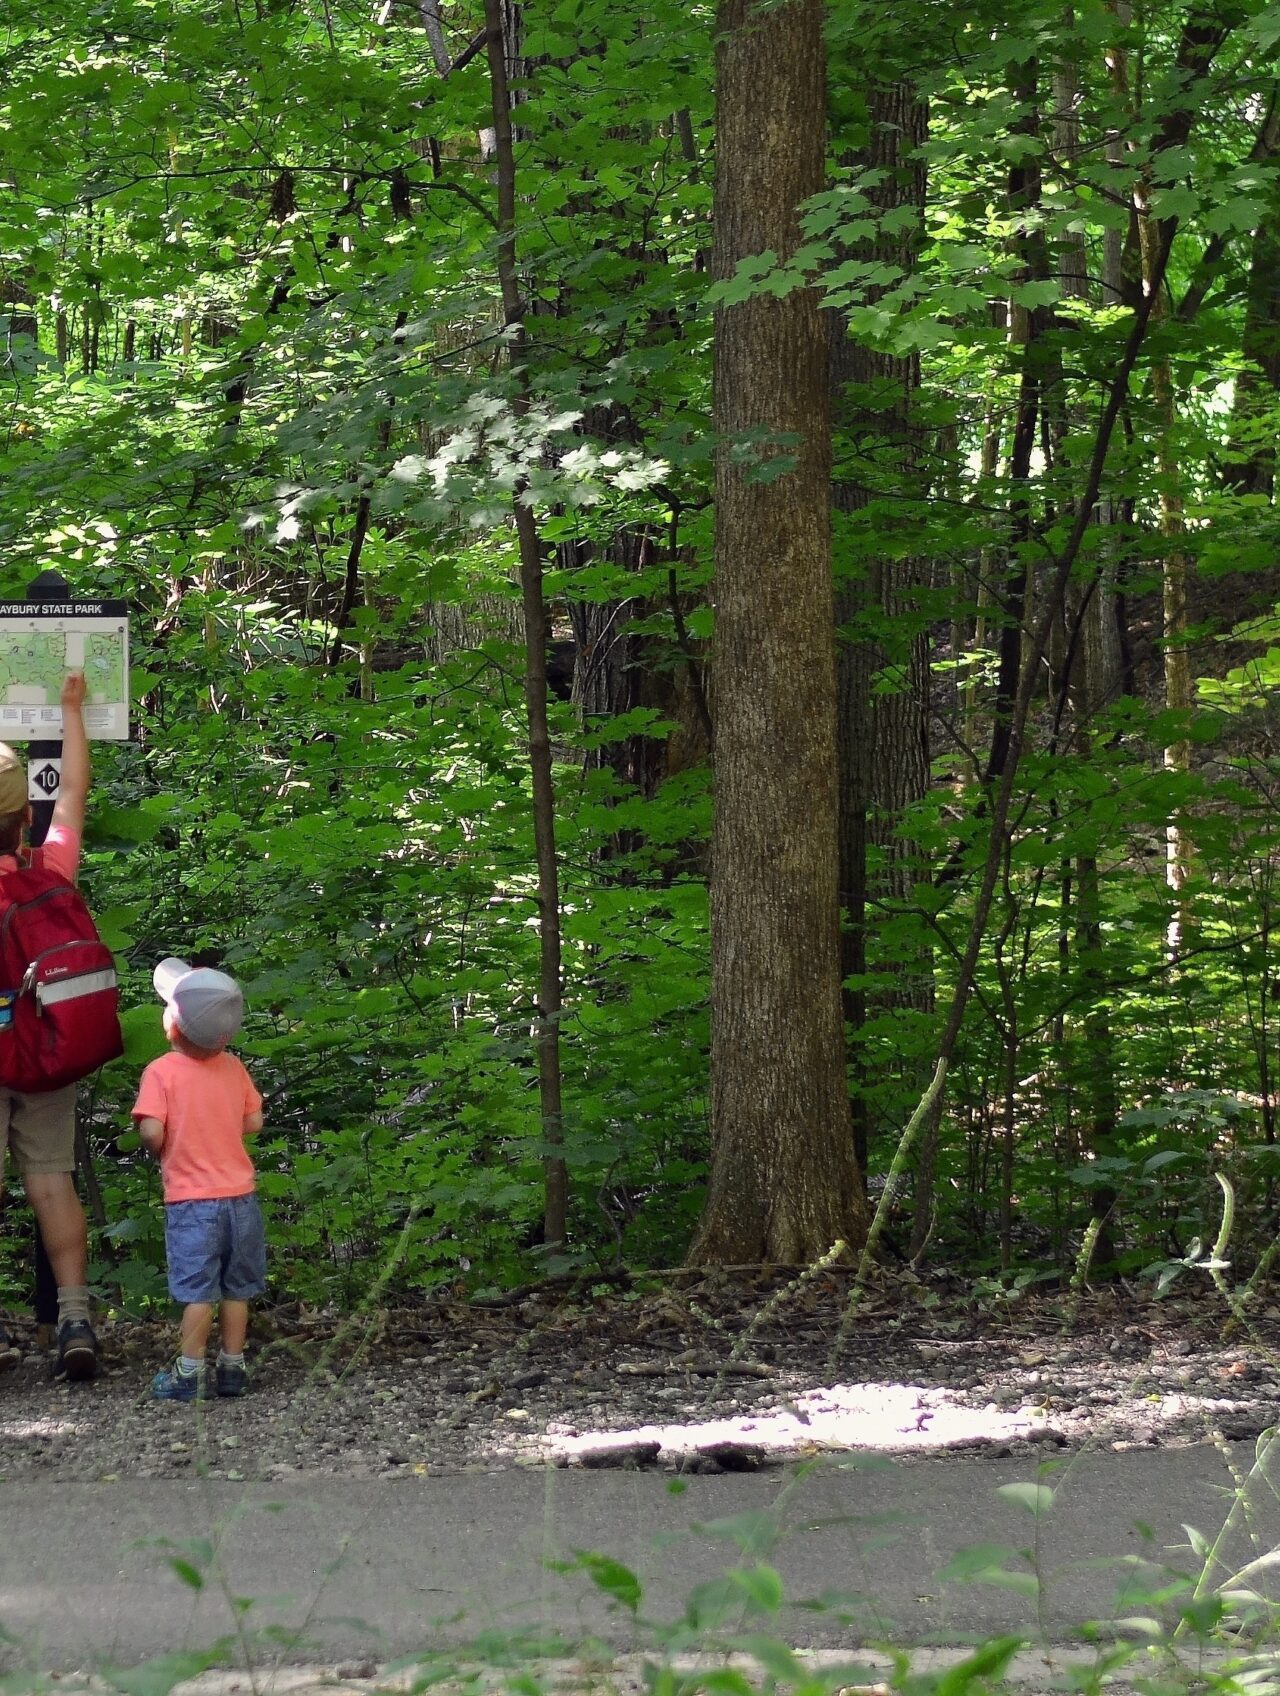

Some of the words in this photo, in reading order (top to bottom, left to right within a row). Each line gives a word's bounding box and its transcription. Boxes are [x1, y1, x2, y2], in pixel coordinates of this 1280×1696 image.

[41, 605, 73, 614] STATE
[74, 604, 102, 614] PARK
[40, 770, 56, 788] 10
